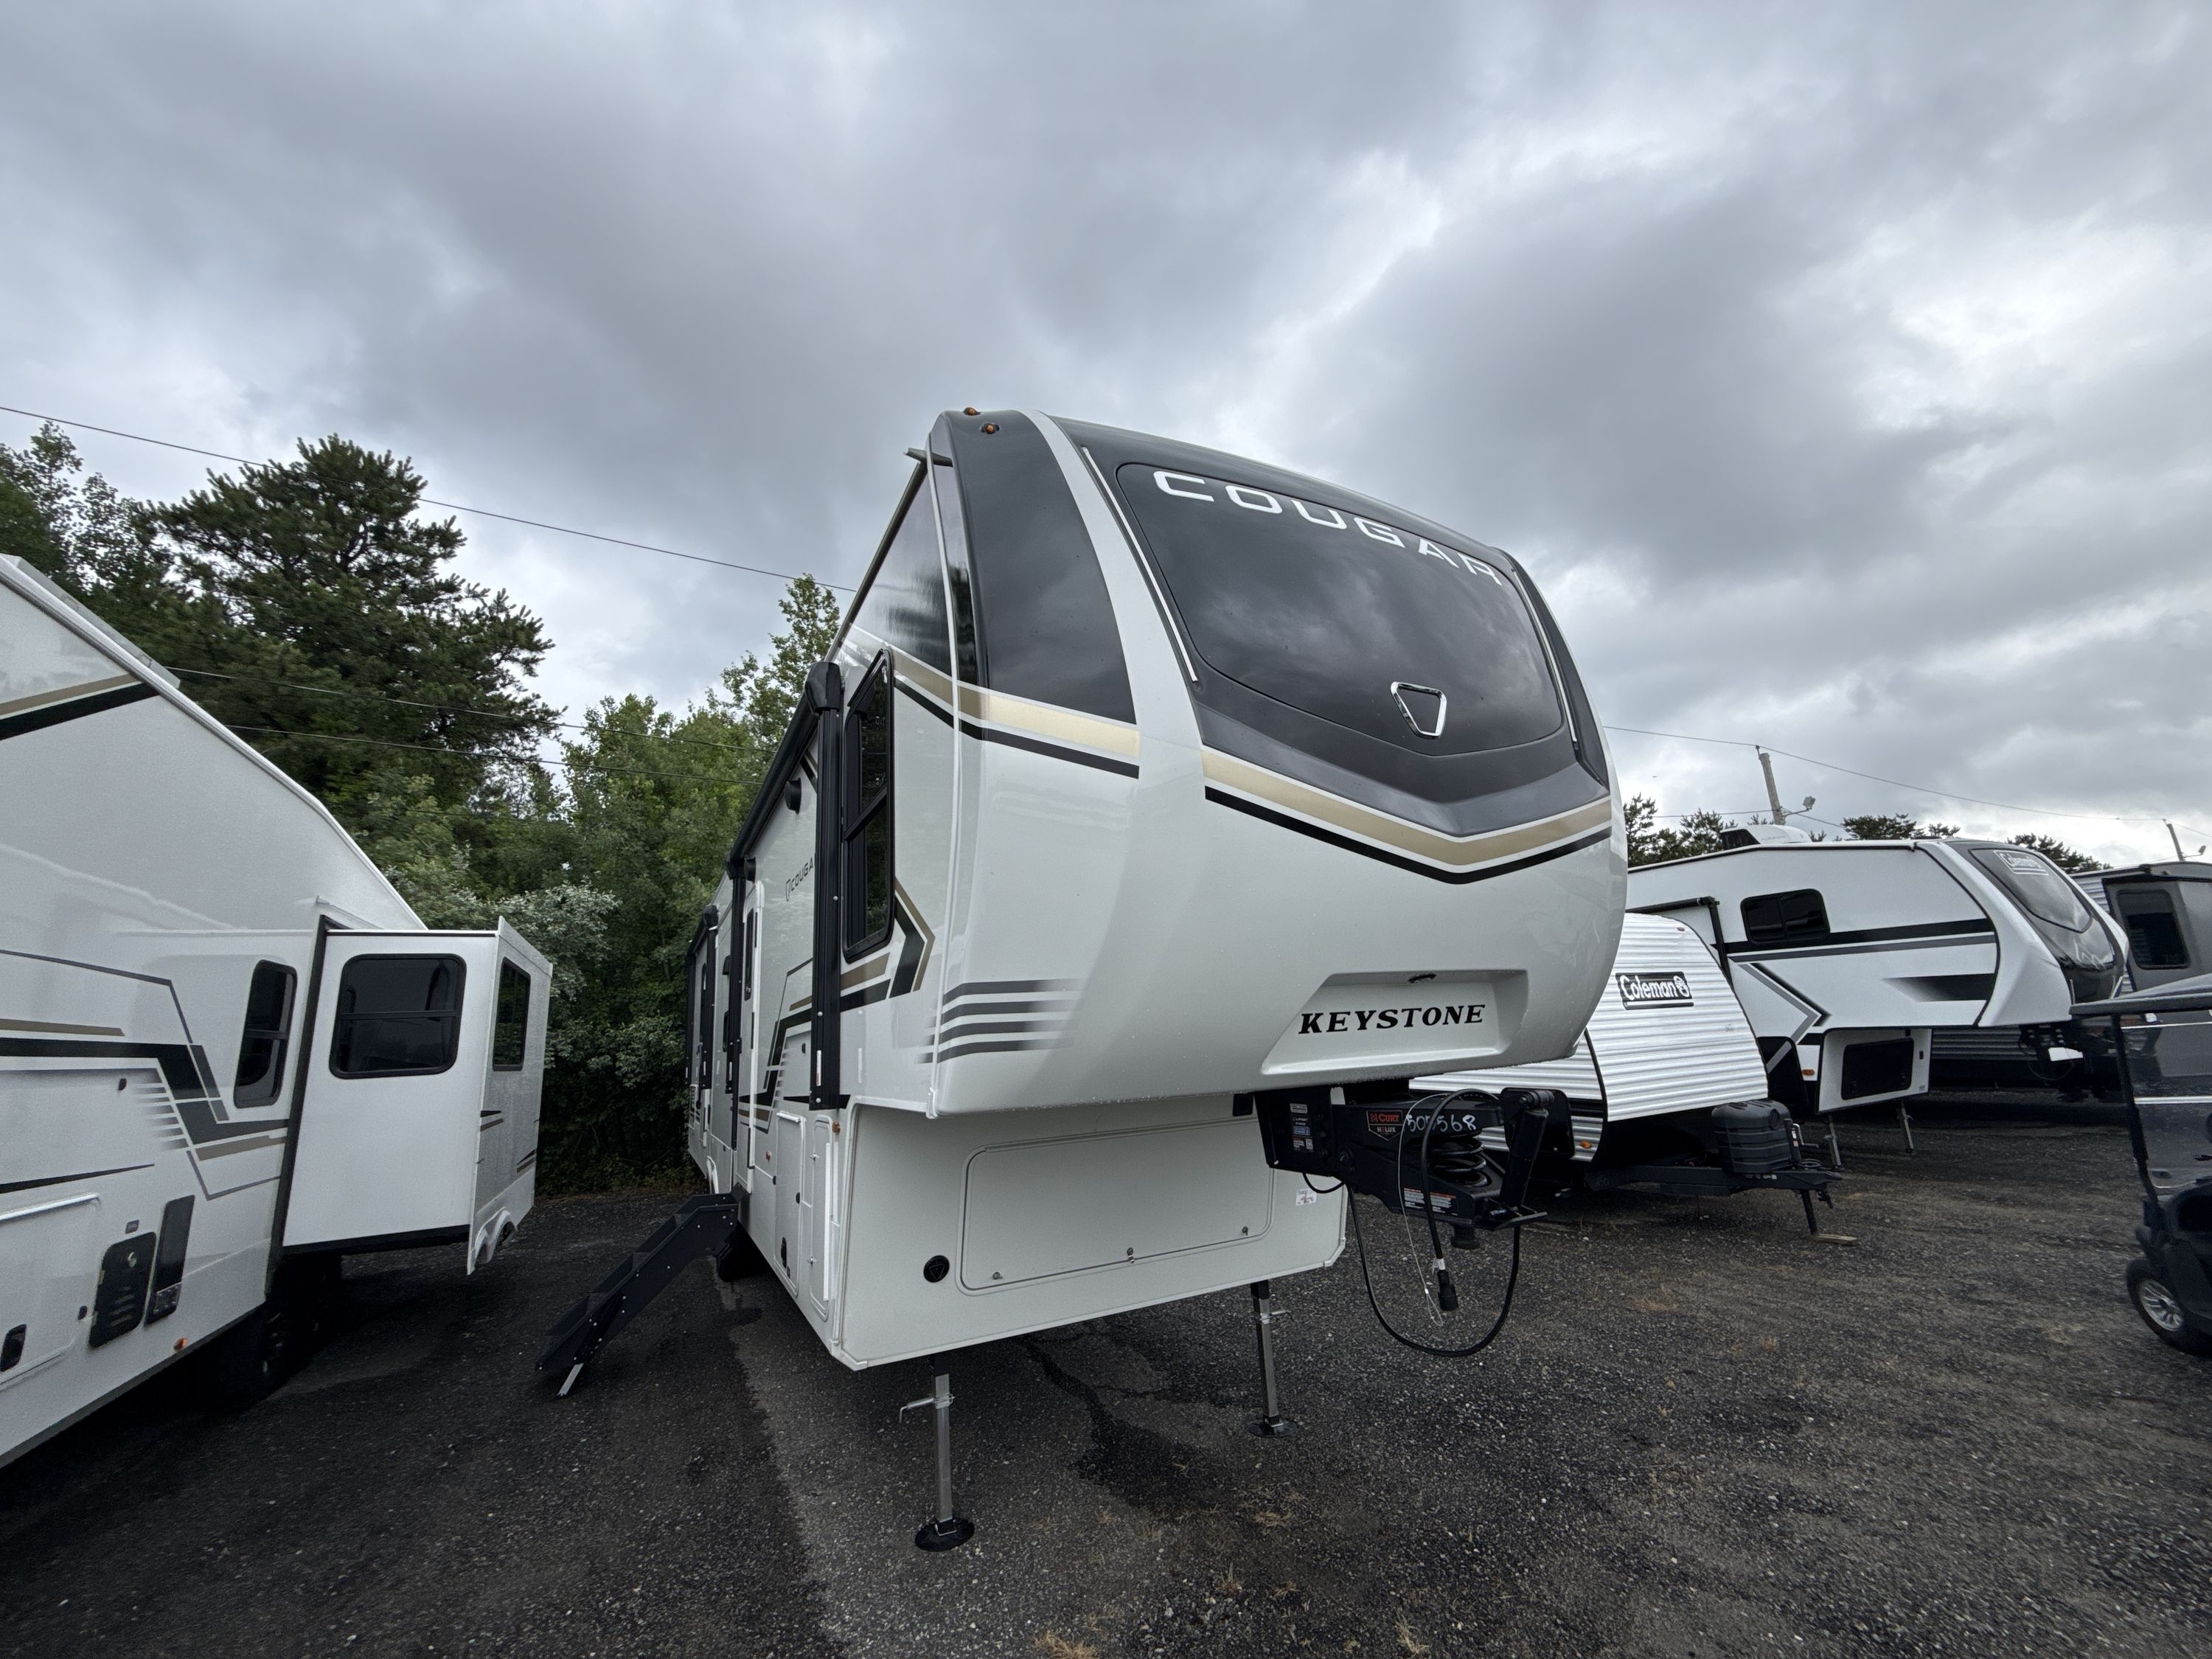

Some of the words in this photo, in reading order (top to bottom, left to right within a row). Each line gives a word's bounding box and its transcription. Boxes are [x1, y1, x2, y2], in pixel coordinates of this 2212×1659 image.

[1153, 470, 1503, 585] COUGAR
[790, 858, 814, 891] COUGA
[1619, 974, 1679, 1001] Coleman
[1298, 1004, 1486, 1034] KEYSTONE
